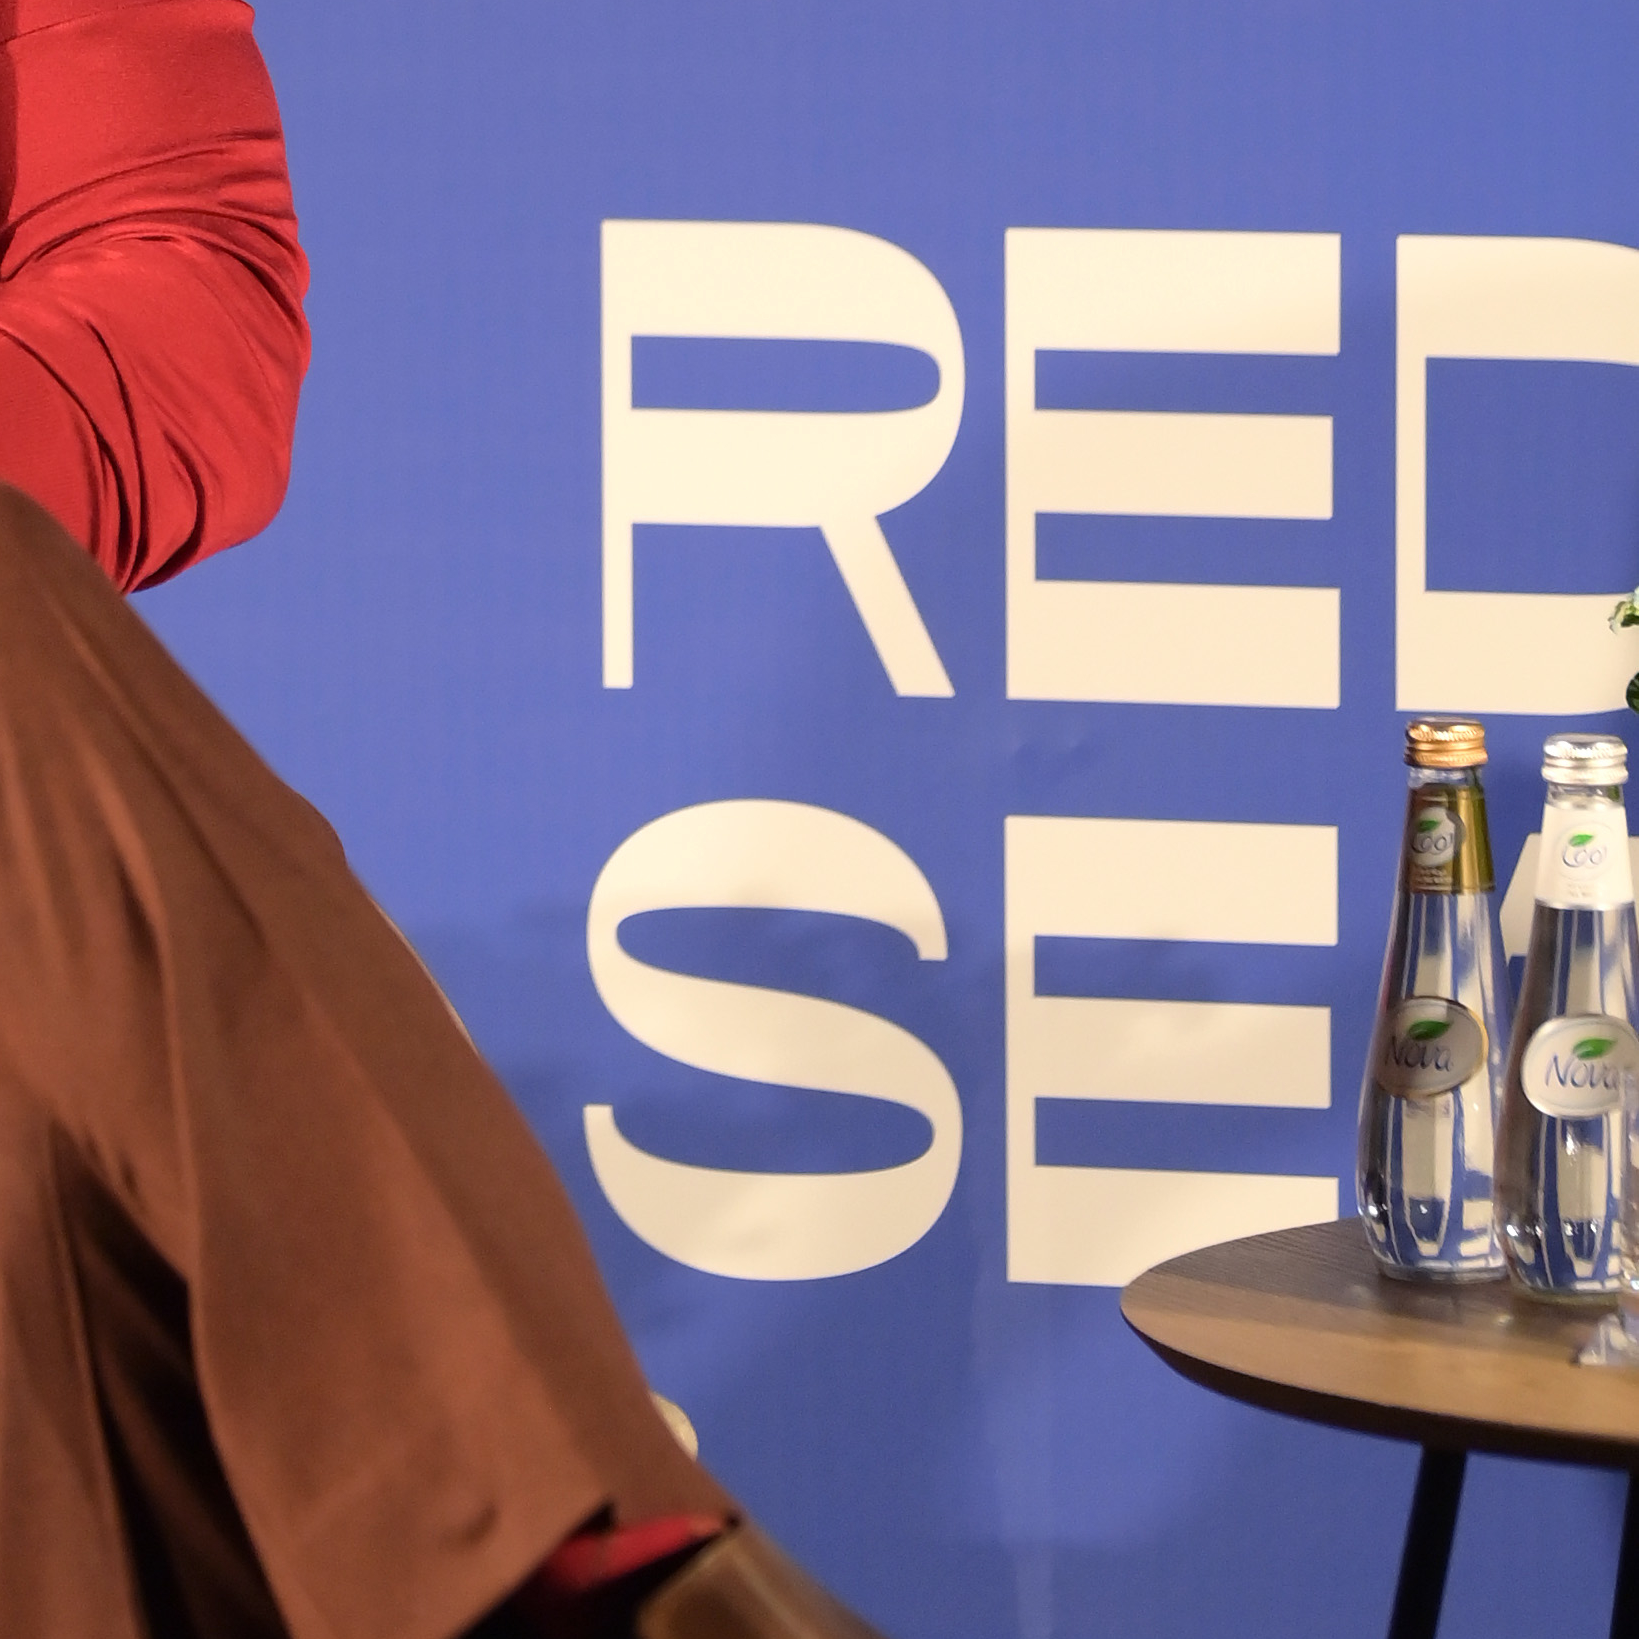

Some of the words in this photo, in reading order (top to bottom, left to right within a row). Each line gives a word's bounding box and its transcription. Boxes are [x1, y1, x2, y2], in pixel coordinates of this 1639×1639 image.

[601, 219, 1639, 714] RED
[583, 799, 1639, 1287] SE
[1385, 1034, 1453, 1073] Nova
[1544, 1052, 1620, 1091] Nova
